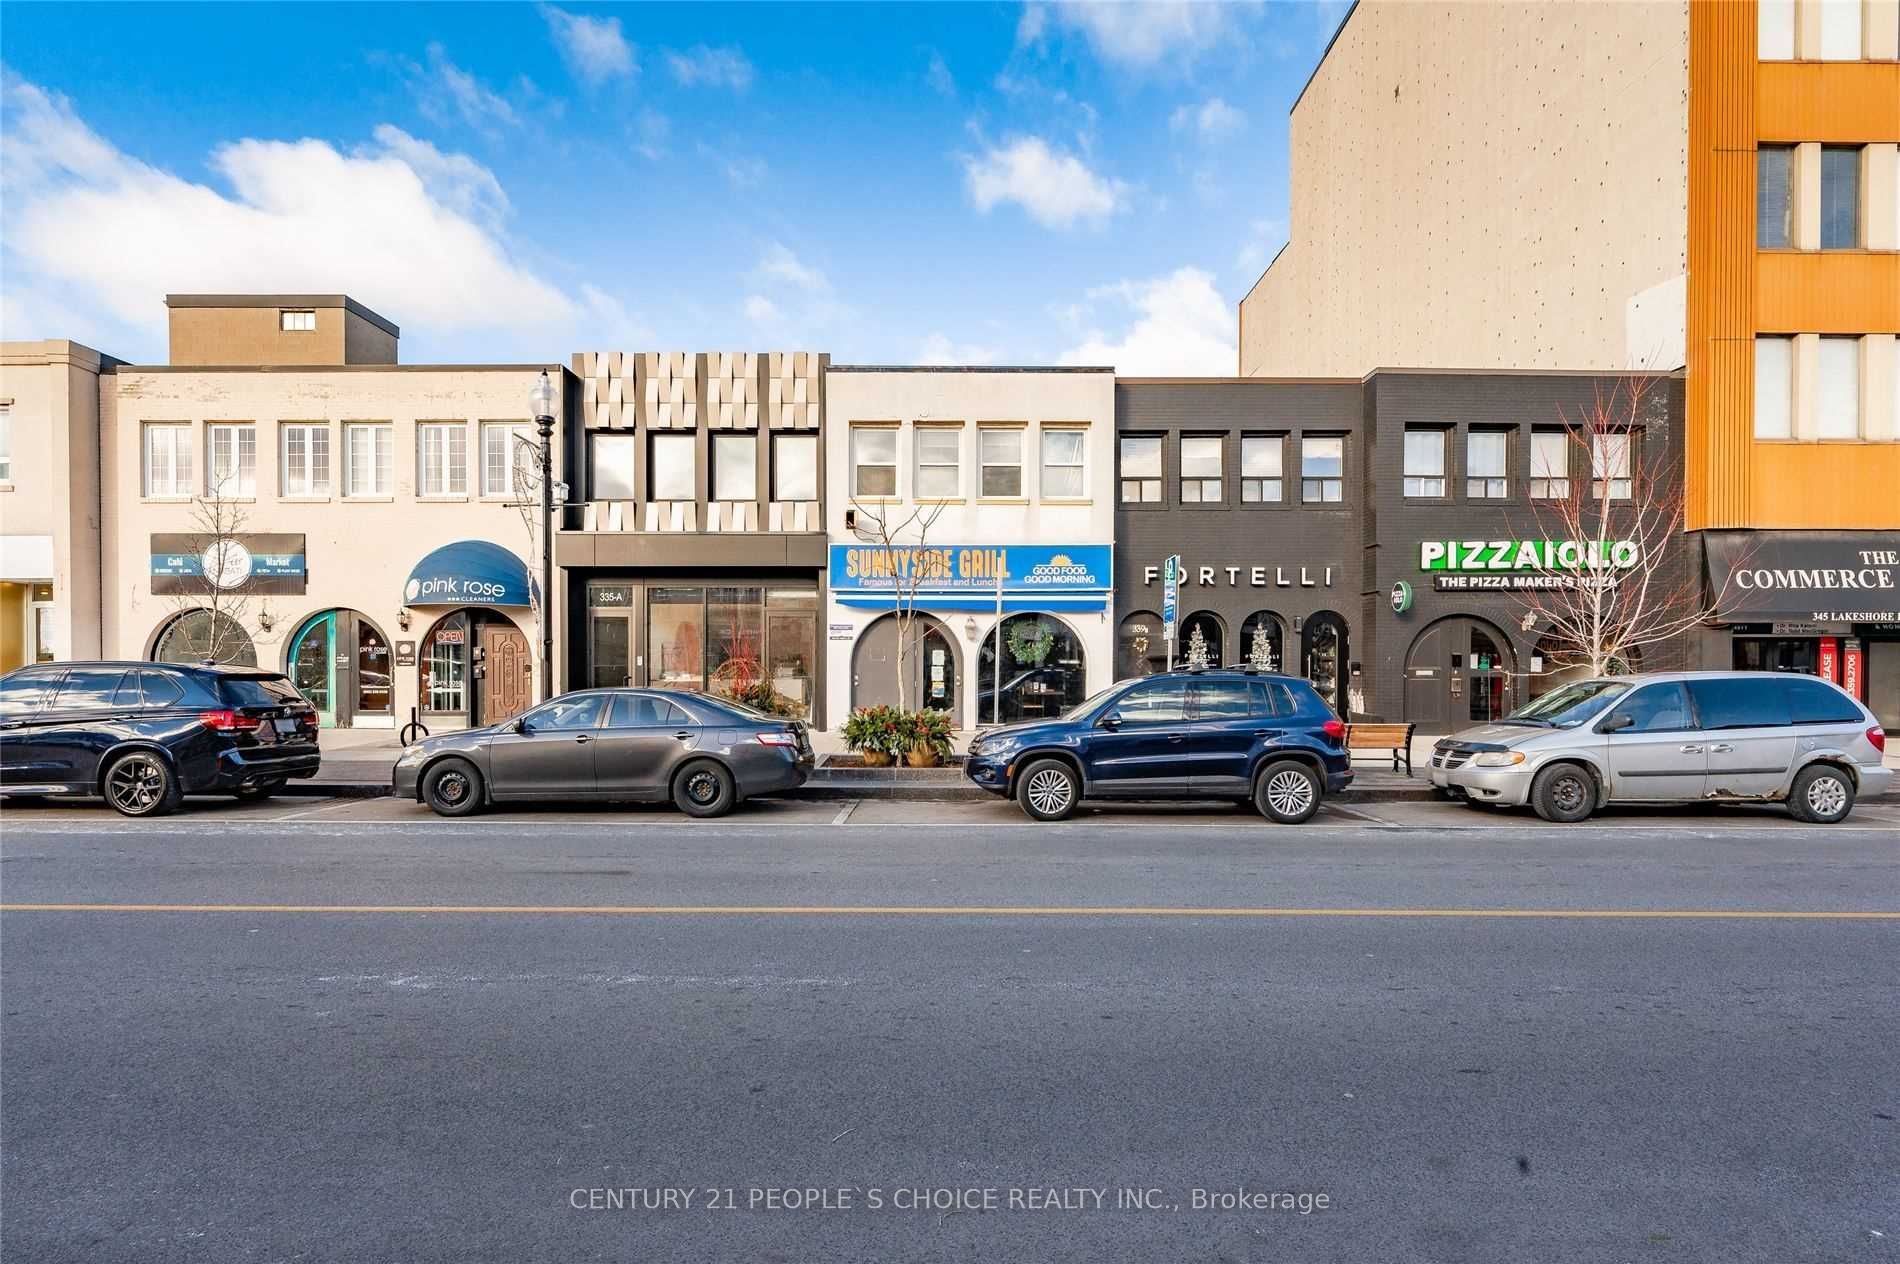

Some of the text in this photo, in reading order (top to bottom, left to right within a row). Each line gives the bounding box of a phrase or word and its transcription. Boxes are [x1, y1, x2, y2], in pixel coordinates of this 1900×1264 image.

[1421, 541, 1638, 569] PIZZAIOLO
[1859, 551, 1899, 565] THE
[846, 549, 1011, 578] SUNNYSIDE GRILL
[1033, 567, 1087, 575] GOOD FOOD
[859, 578, 893, 586] Famous
[953, 578, 970, 586] and
[1024, 575, 1095, 584] GOOD MORNING
[1440, 577, 1467, 587] THE
[1469, 577, 1511, 587] PIZZA
[1513, 575, 1574, 587] MAKER'S
[1735, 569, 1895, 589] COMMERCE
[422, 577, 506, 598] pink rose
[600, 592, 623, 602] 335-A
[1812, 612, 1829, 621] 345
[1831, 612, 1895, 621] LAKESHORE
[437, 631, 465, 641] OPEN
[1824, 653, 1832, 681] EASE
